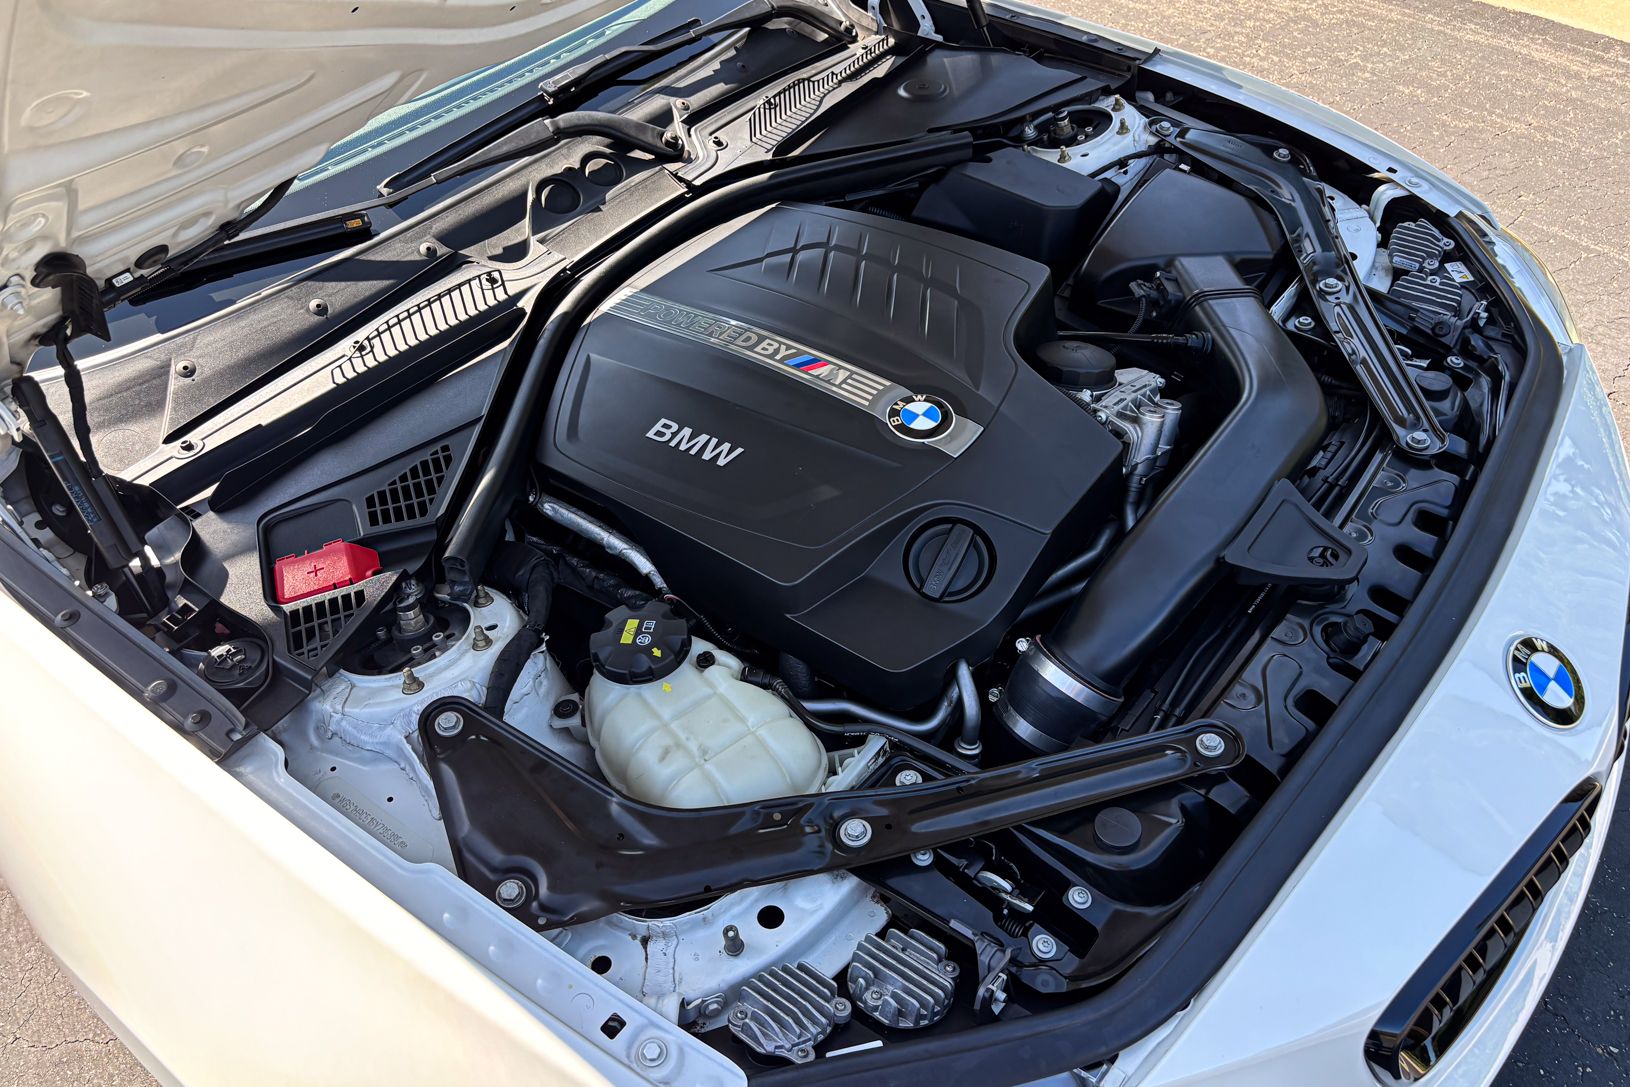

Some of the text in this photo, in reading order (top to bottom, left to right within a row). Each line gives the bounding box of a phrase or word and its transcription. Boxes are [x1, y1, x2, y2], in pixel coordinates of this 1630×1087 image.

[640, 302, 759, 347] POWERED
[754, 338, 797, 360] BY
[890, 394, 926, 426] BMW
[645, 418, 745, 467] BMW
[1513, 637, 1549, 688] BMW
